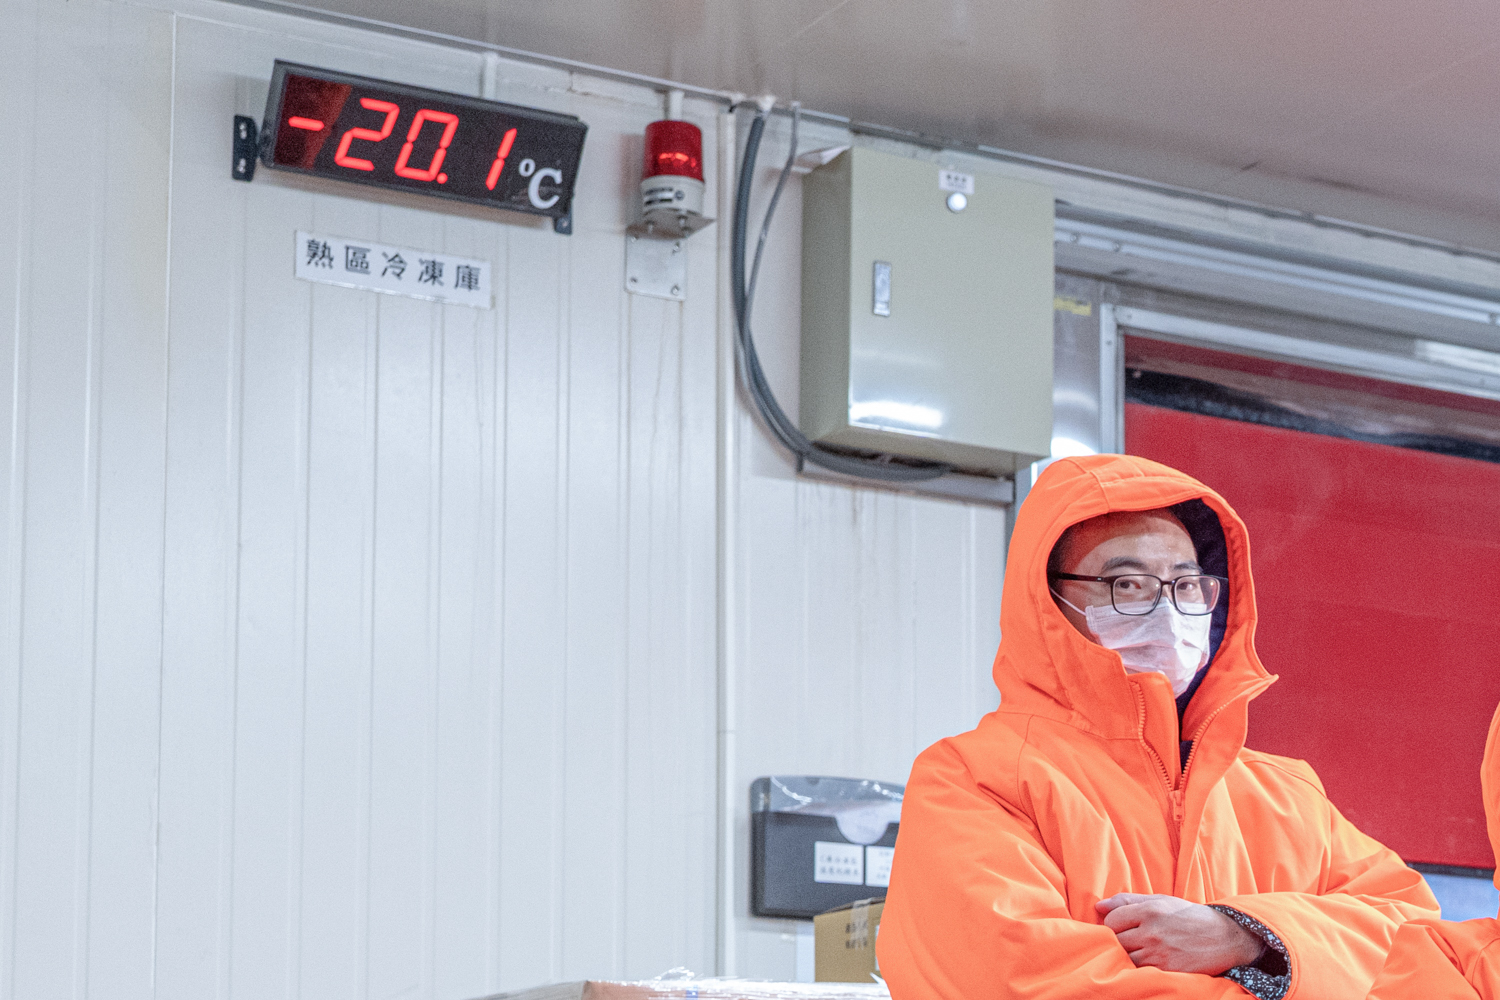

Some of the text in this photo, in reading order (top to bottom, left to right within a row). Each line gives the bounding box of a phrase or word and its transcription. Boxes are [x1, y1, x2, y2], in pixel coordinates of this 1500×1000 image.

[306, 239, 482, 292] 熟區冷凍庫
